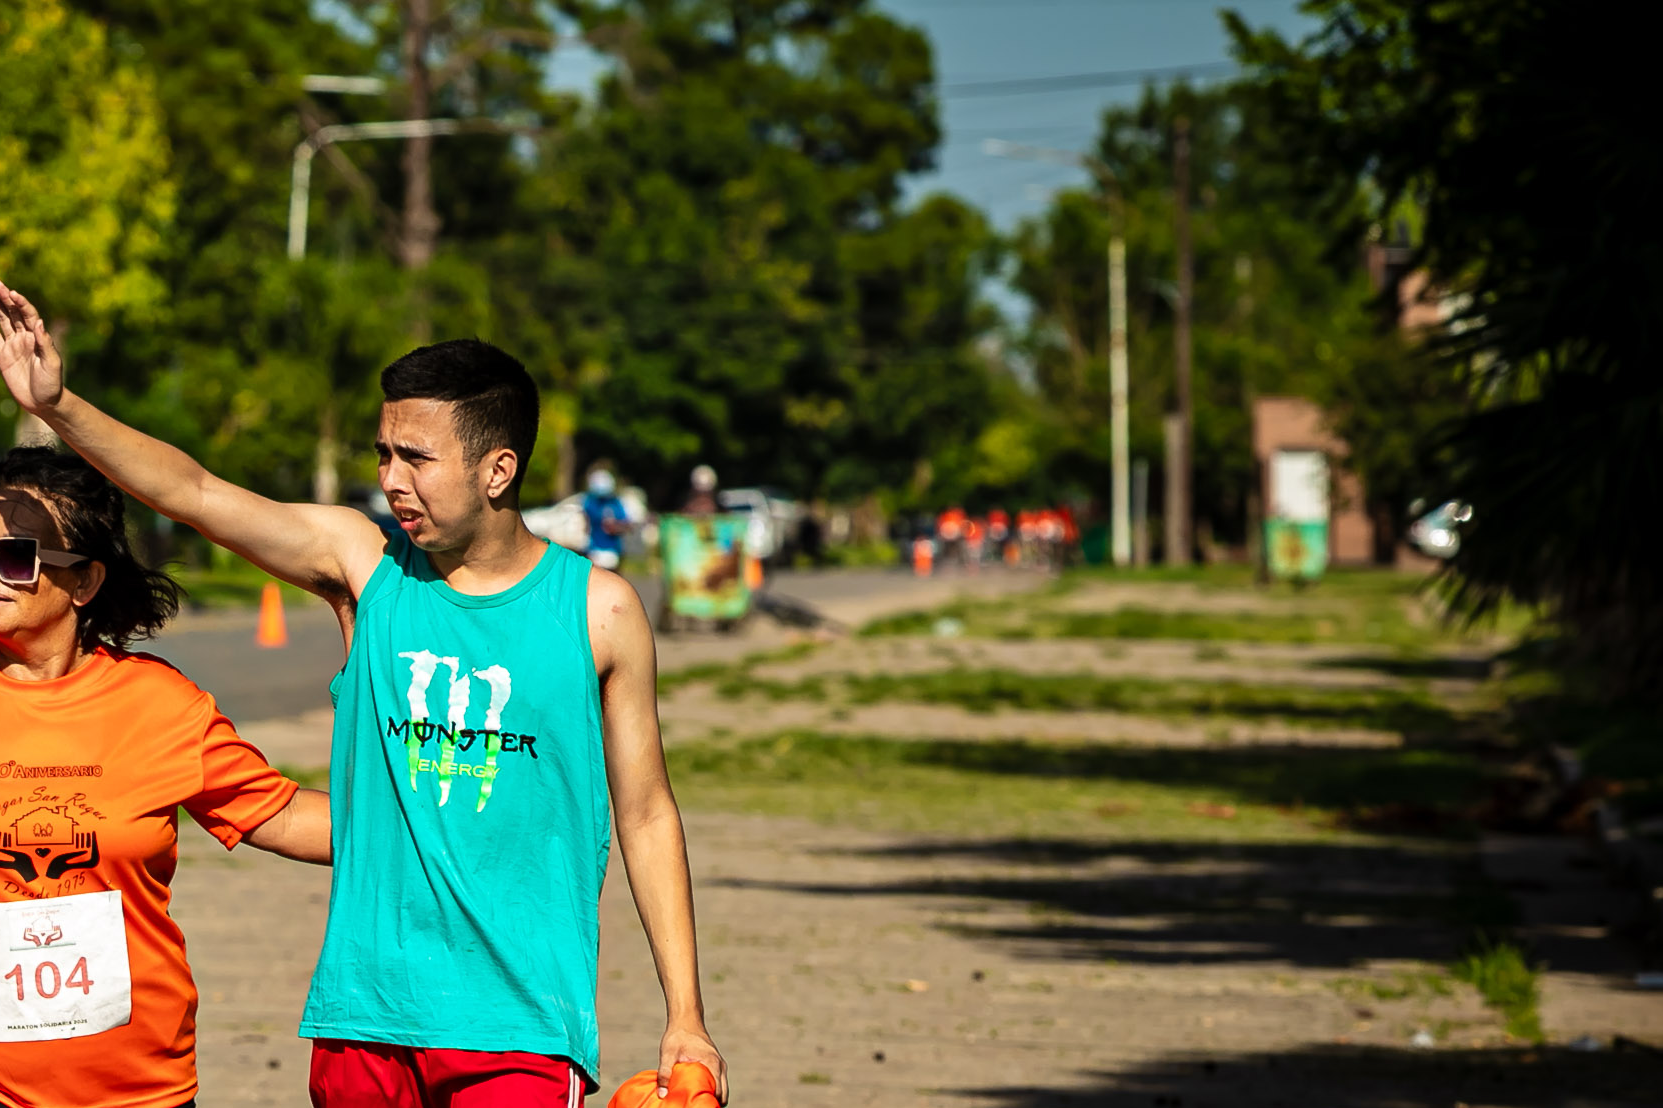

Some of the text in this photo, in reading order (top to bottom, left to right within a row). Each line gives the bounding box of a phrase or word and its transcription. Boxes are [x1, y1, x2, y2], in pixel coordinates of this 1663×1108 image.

[387, 716, 538, 759] MONSTER
[12, 764, 103, 779] ANIVERSARIO
[417, 758, 500, 778] ENERGY
[27, 786, 59, 803] San
[64, 792, 107, 820] Roque
[57, 871, 86, 897] 1975
[4, 956, 95, 1001] 104
